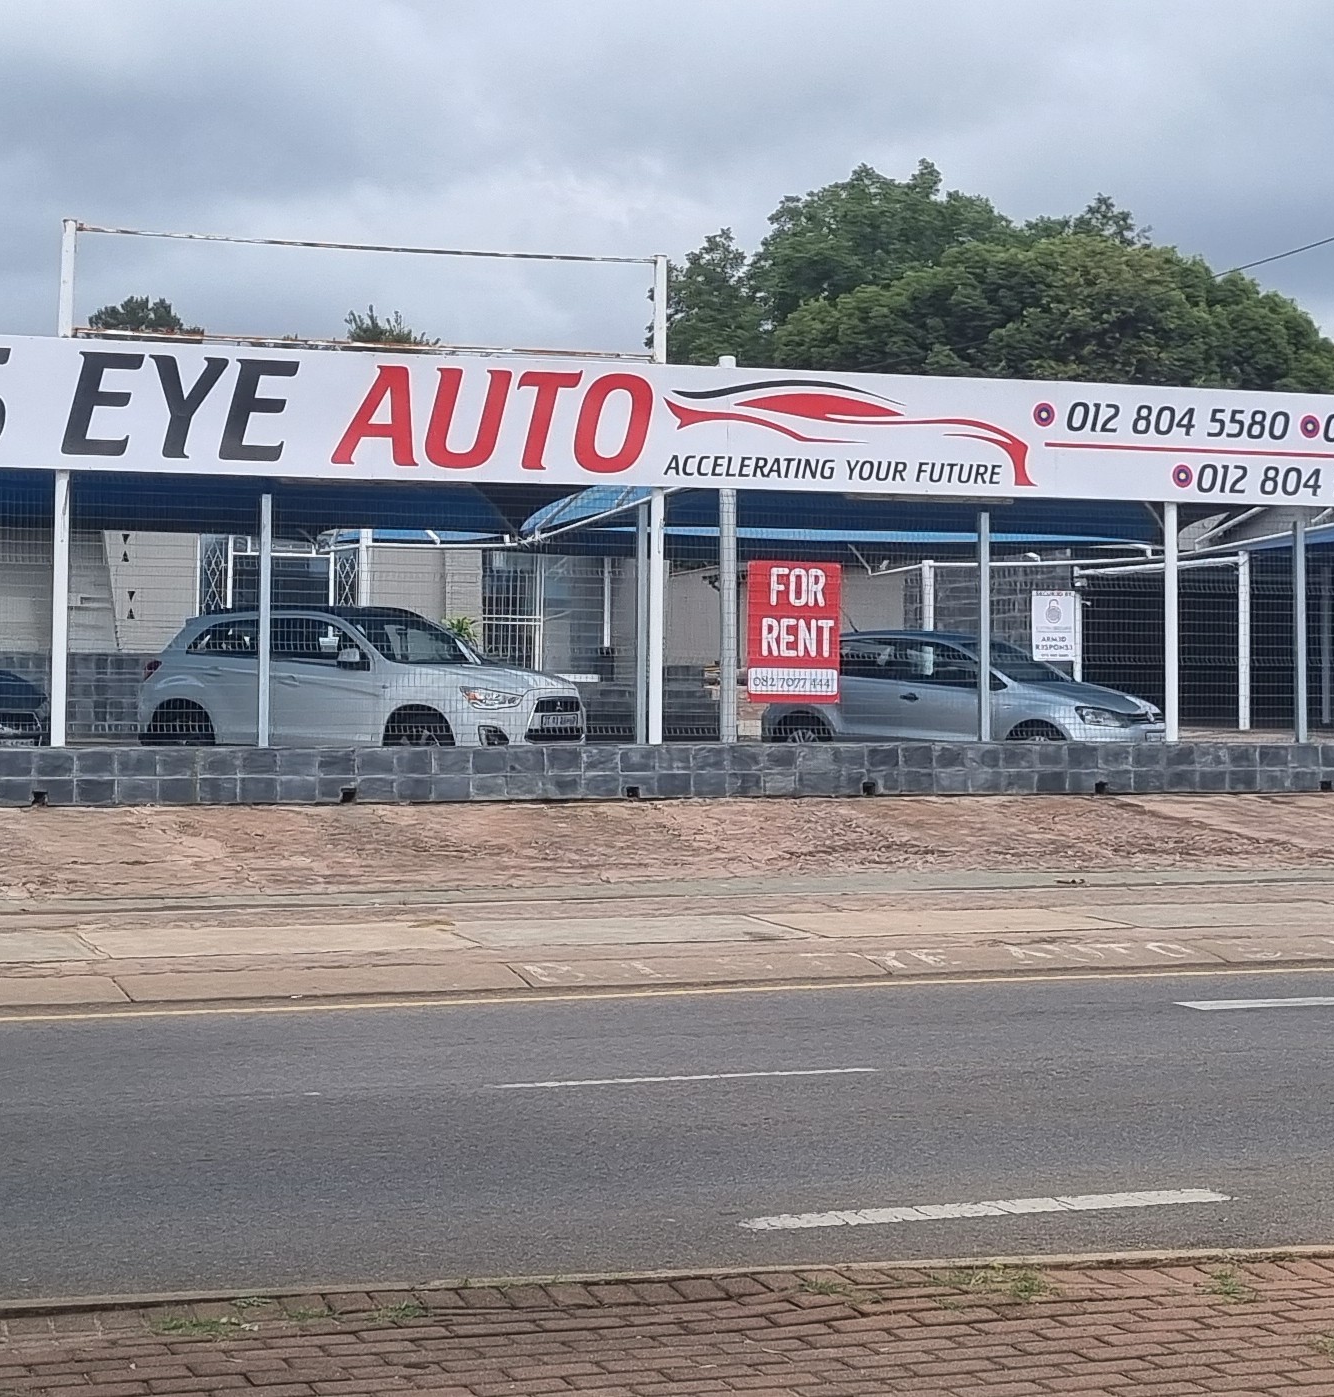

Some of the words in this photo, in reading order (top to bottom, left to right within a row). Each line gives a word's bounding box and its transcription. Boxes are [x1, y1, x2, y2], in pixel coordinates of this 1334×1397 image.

[59, 350, 300, 461] EYE
[330, 365, 655, 474] AUTO
[1066, 401, 1121, 433] 012
[1132, 404, 1196, 437] 804
[1206, 408, 1291, 441] 5580
[663, 454, 836, 480] ACCELERATING
[847, 459, 908, 482] YOUR
[915, 462, 1003, 485] FUTURE
[1196, 463, 1248, 494] 012
[1259, 466, 1322, 497] 804
[770, 567, 826, 607] FOR
[761, 617, 835, 658] RENT
